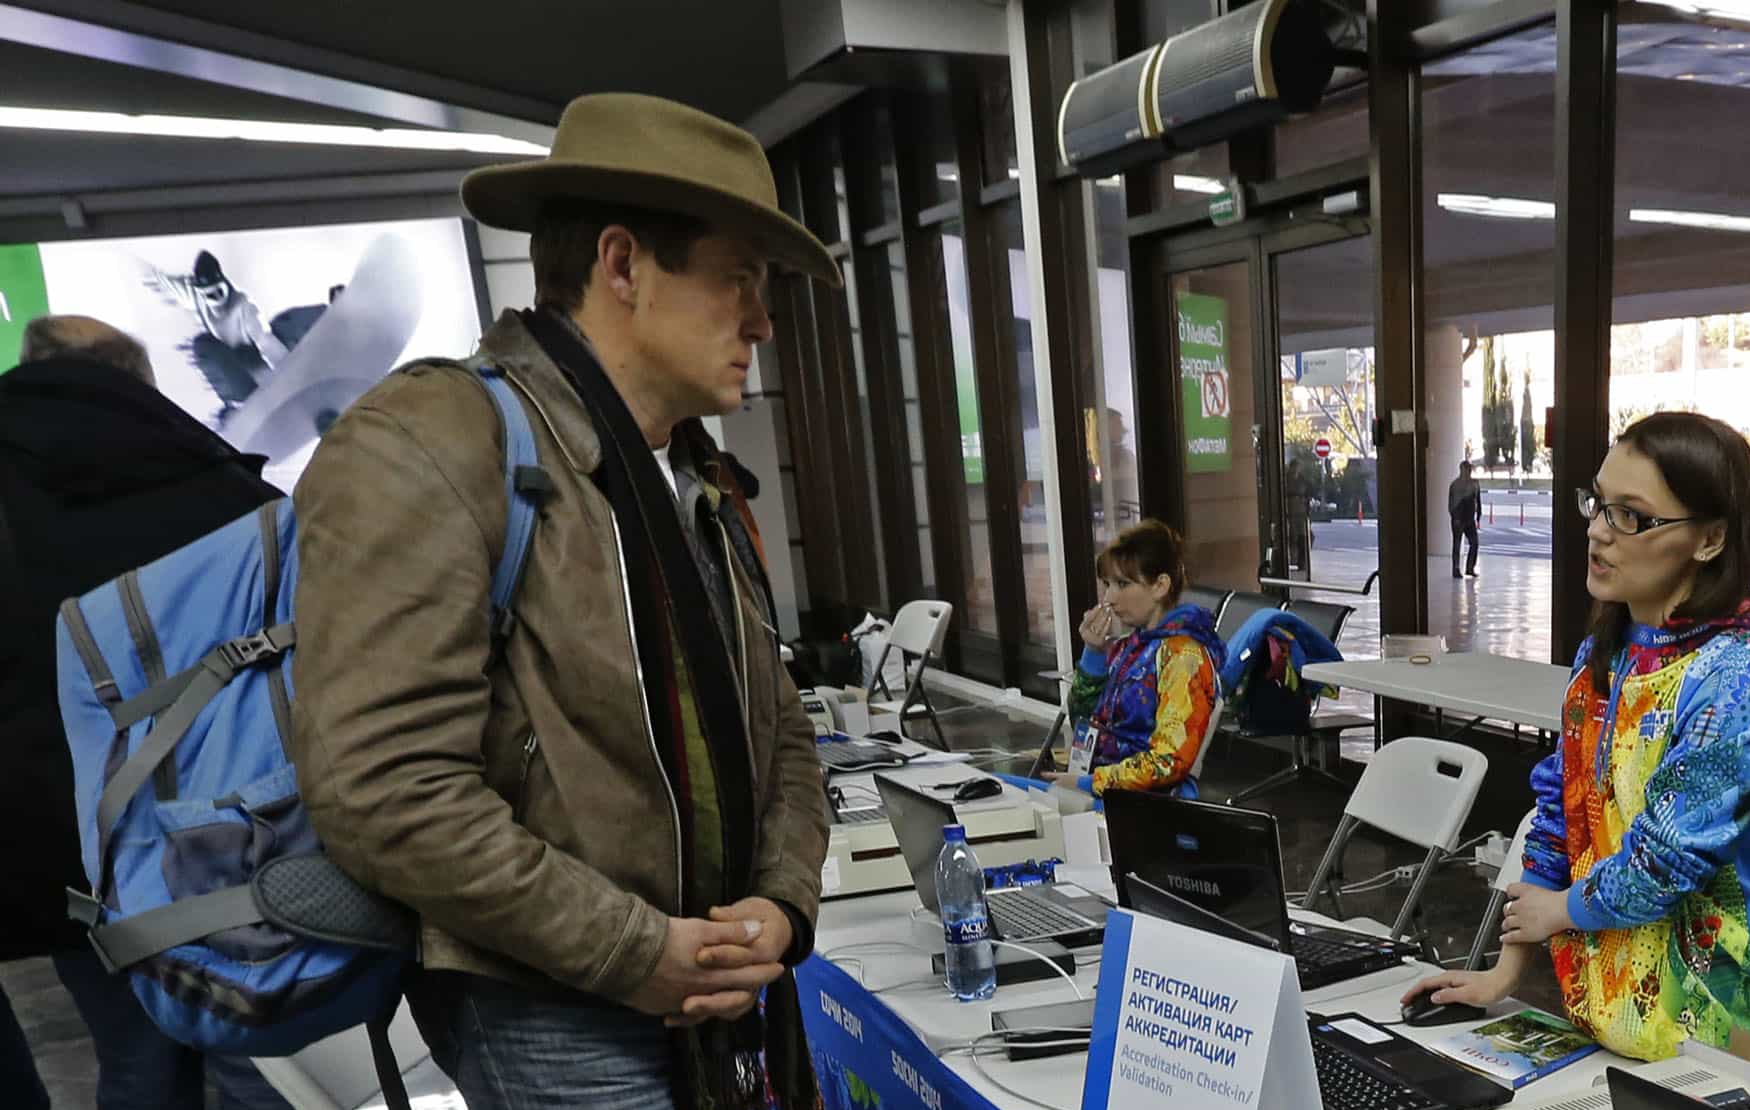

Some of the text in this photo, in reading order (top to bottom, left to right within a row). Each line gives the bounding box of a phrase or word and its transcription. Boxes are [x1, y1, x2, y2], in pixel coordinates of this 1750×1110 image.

[1168, 875, 1221, 896] TOSHIBA
[1132, 967, 1238, 1015] РЕГИСТРАЦИЯ/
[842, 1006, 864, 1043] 2014
[1125, 1015, 1236, 1069] АККРЕДИТАЦИИ
[1128, 992, 1253, 1047] АКТИВАЦИЯ КАРТ
[891, 1050, 918, 1093] SOCHI
[1119, 1064, 1173, 1096] Validation
[1121, 1044, 1253, 1104] Accreditation Check-in/
